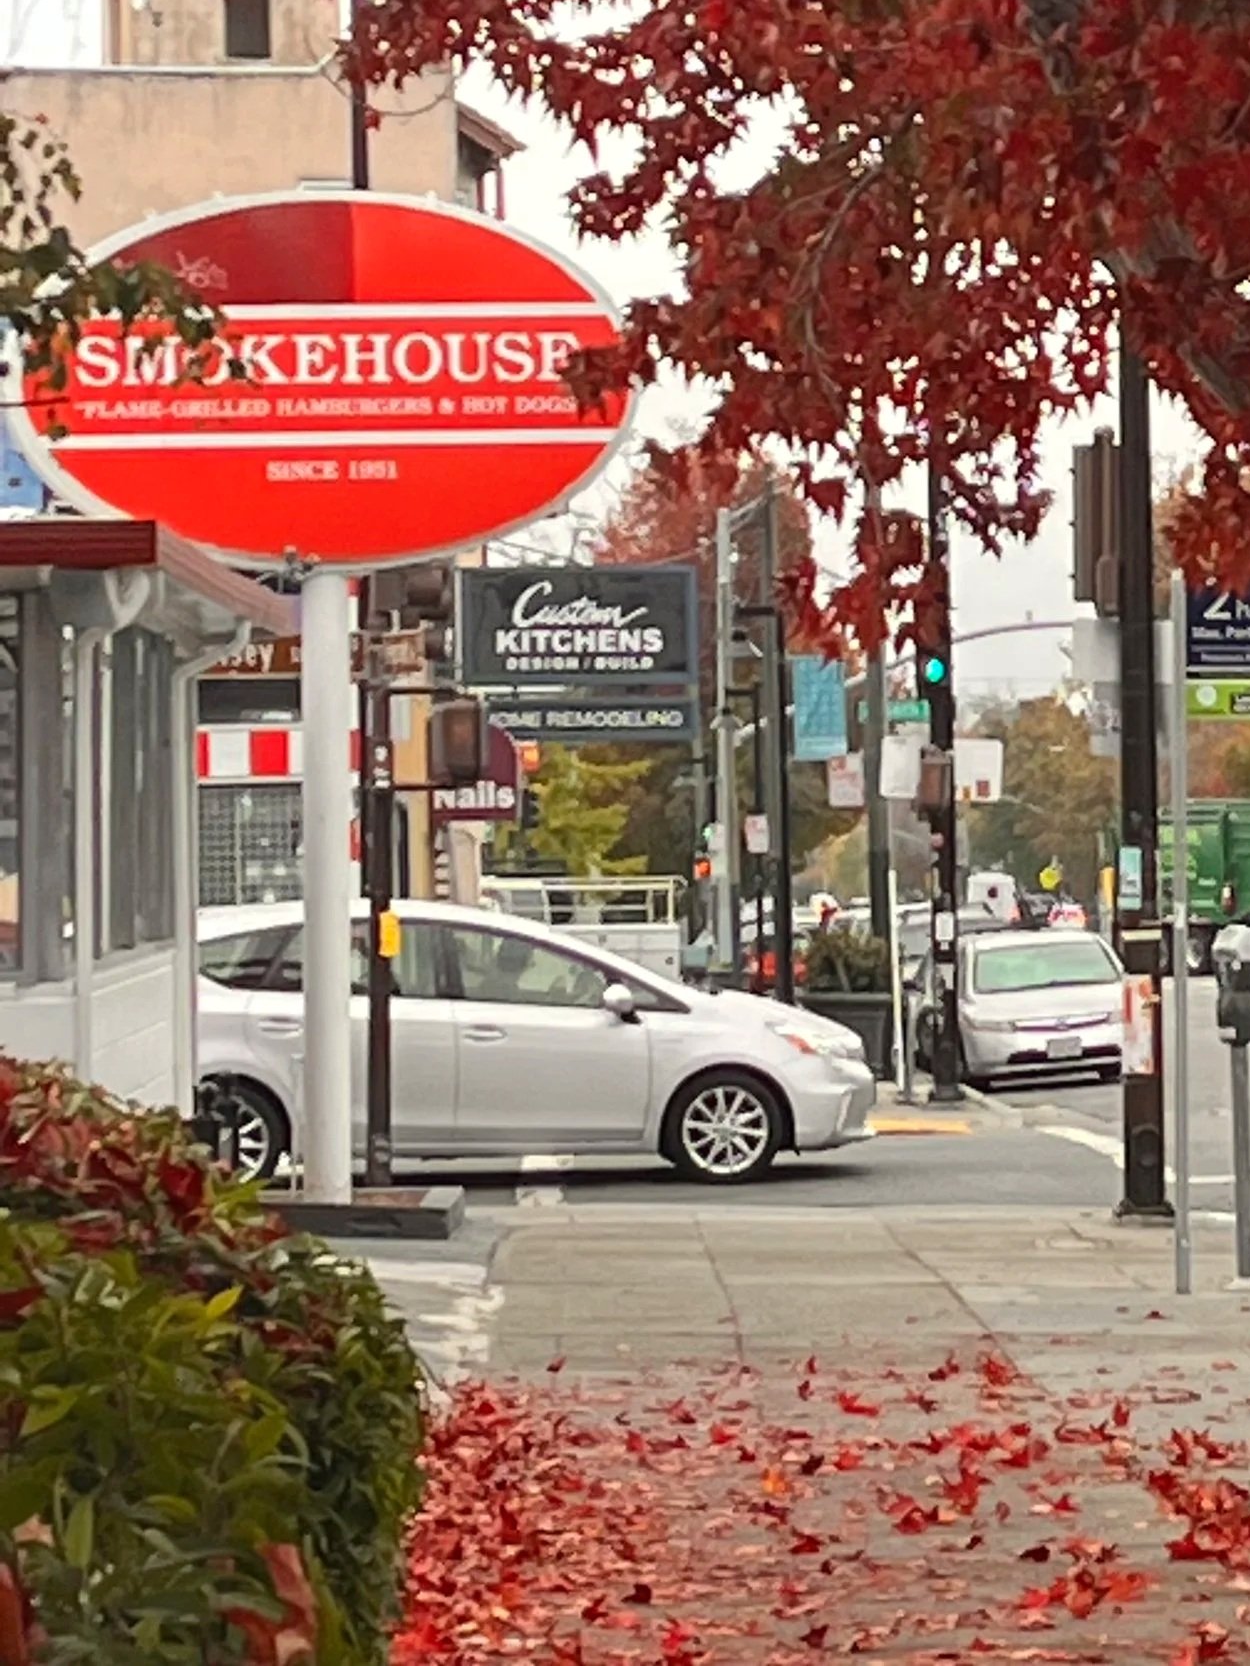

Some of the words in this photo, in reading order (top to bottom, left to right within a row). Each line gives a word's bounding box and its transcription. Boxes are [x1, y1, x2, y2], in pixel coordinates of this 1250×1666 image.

[276, 396, 433, 417] HAMBURGERS
[438, 397, 455, 415] &
[462, 396, 508, 415] HOT
[266, 460, 339, 481] SINCE
[512, 580, 648, 627] Custom
[495, 628, 664, 654] KITCHENS
[506, 656, 580, 670] DESIGN
[594, 655, 654, 670] BUILD
[546, 710, 683, 727] REMODELING
[432, 781, 515, 809] Nails
